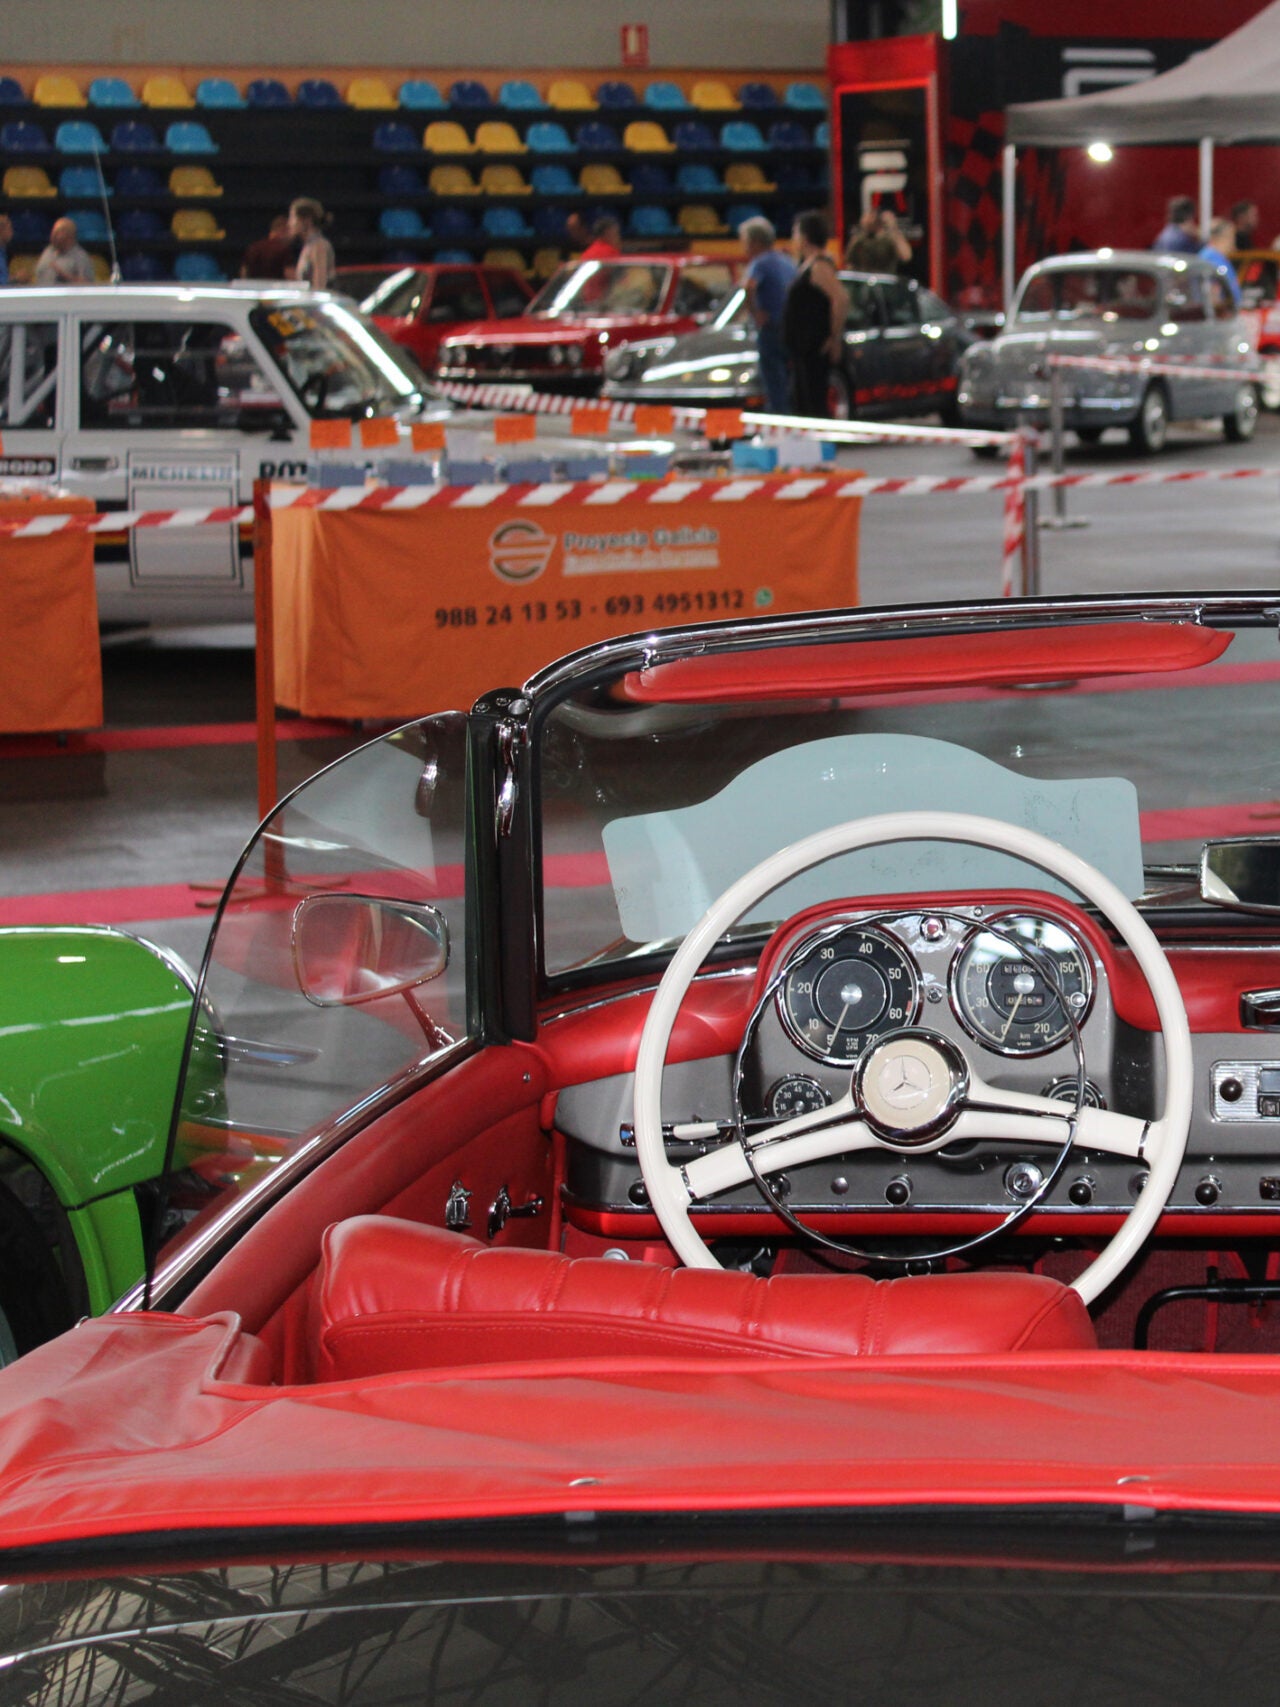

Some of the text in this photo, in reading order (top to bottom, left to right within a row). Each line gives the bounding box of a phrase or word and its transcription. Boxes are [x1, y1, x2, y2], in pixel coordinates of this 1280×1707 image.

[131, 465, 234, 481] MICHELIN
[435, 608, 477, 628] 988
[486, 604, 512, 625] 24
[522, 602, 547, 621] 13
[556, 599, 582, 620] 53
[605, 594, 644, 615] 693
[653, 589, 744, 613] 4951312
[820, 947, 835, 960] 30
[859, 942, 873, 954] 40
[976, 961, 991, 974] 60
[1060, 961, 1075, 973] 150
[888, 968, 902, 979] 50
[797, 982, 811, 994] 20
[976, 996, 989, 1008] 30
[889, 1008, 903, 1019] 60
[808, 1018, 819, 1030] 10
[1033, 1022, 1050, 1034] 210
[1019, 1032, 1031, 1040] km
[783, 1091, 792, 1099] 30
